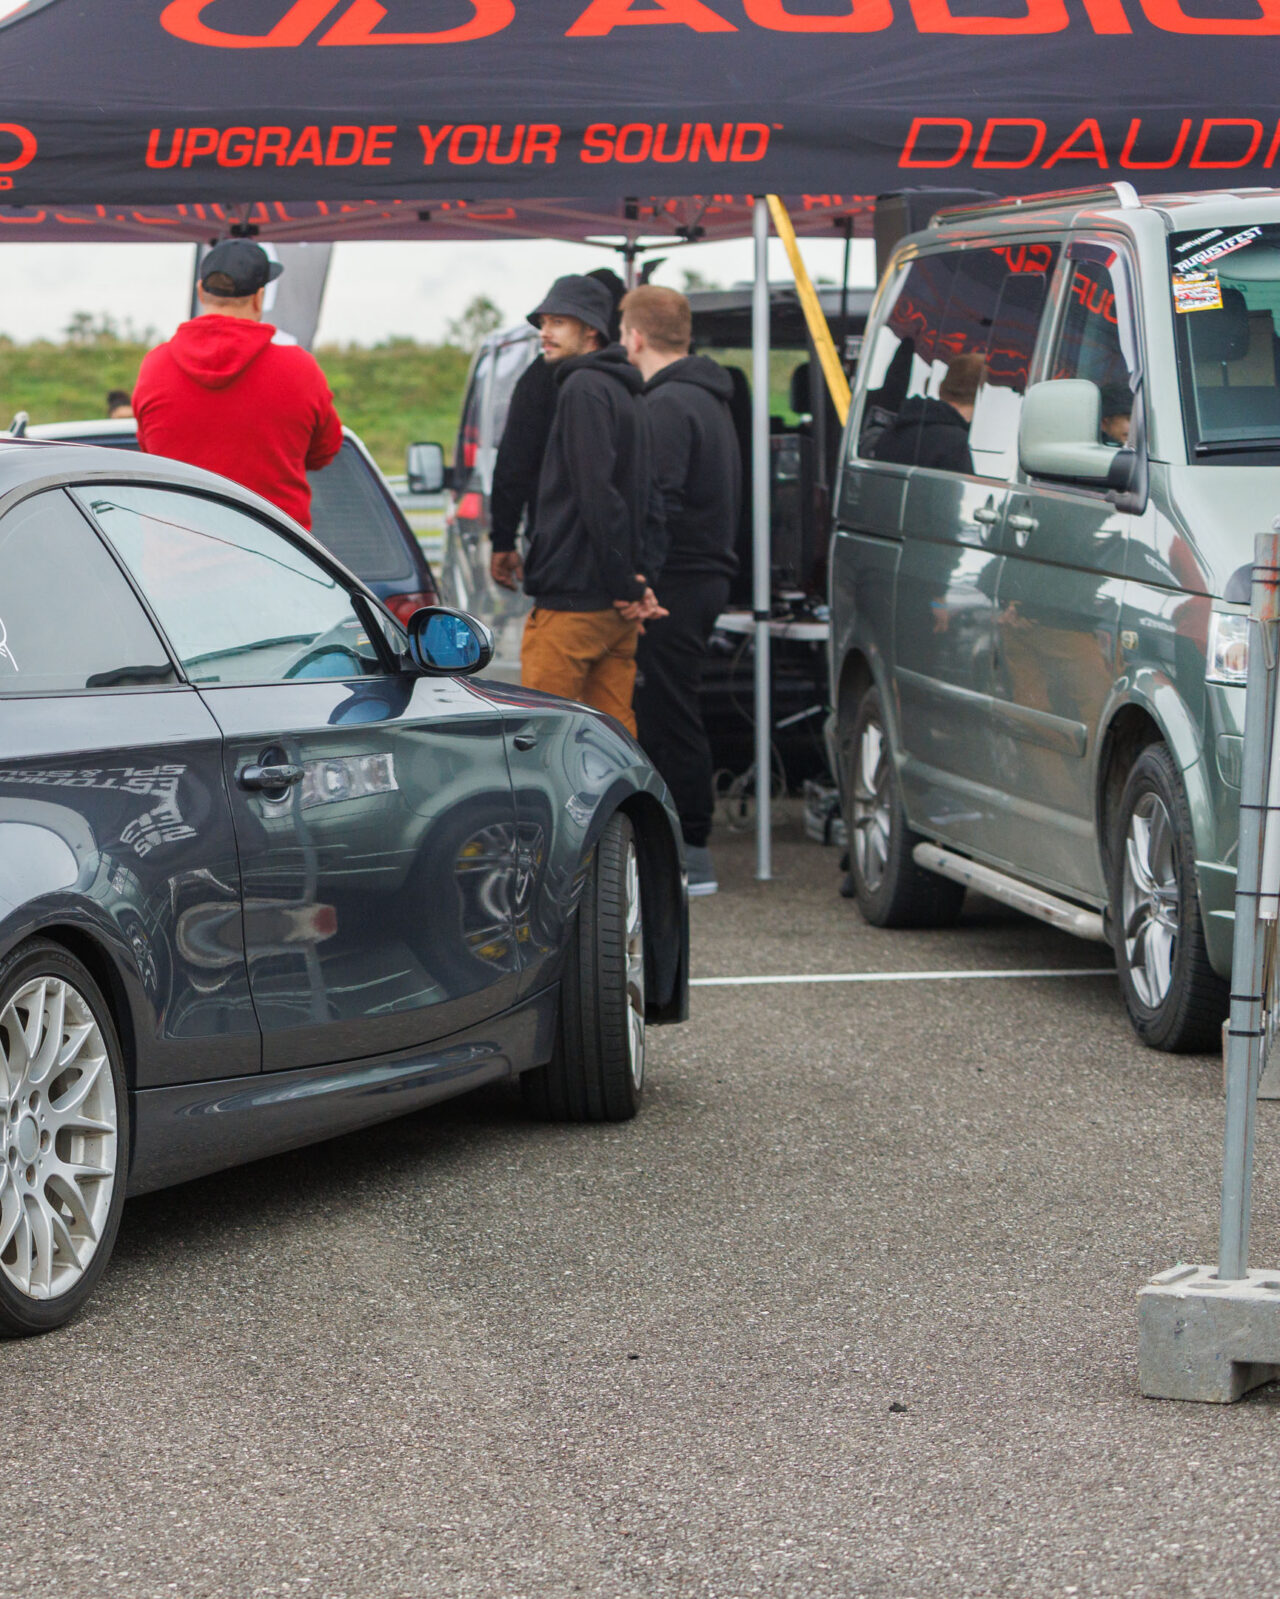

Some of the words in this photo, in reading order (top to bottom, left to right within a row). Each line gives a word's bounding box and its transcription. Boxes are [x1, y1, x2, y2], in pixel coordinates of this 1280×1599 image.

[146, 126, 397, 168] UPGRADE
[419, 124, 561, 165] YOUR
[580, 123, 770, 163] SOUND
[1173, 226, 1263, 273] AUGUSTFEST
